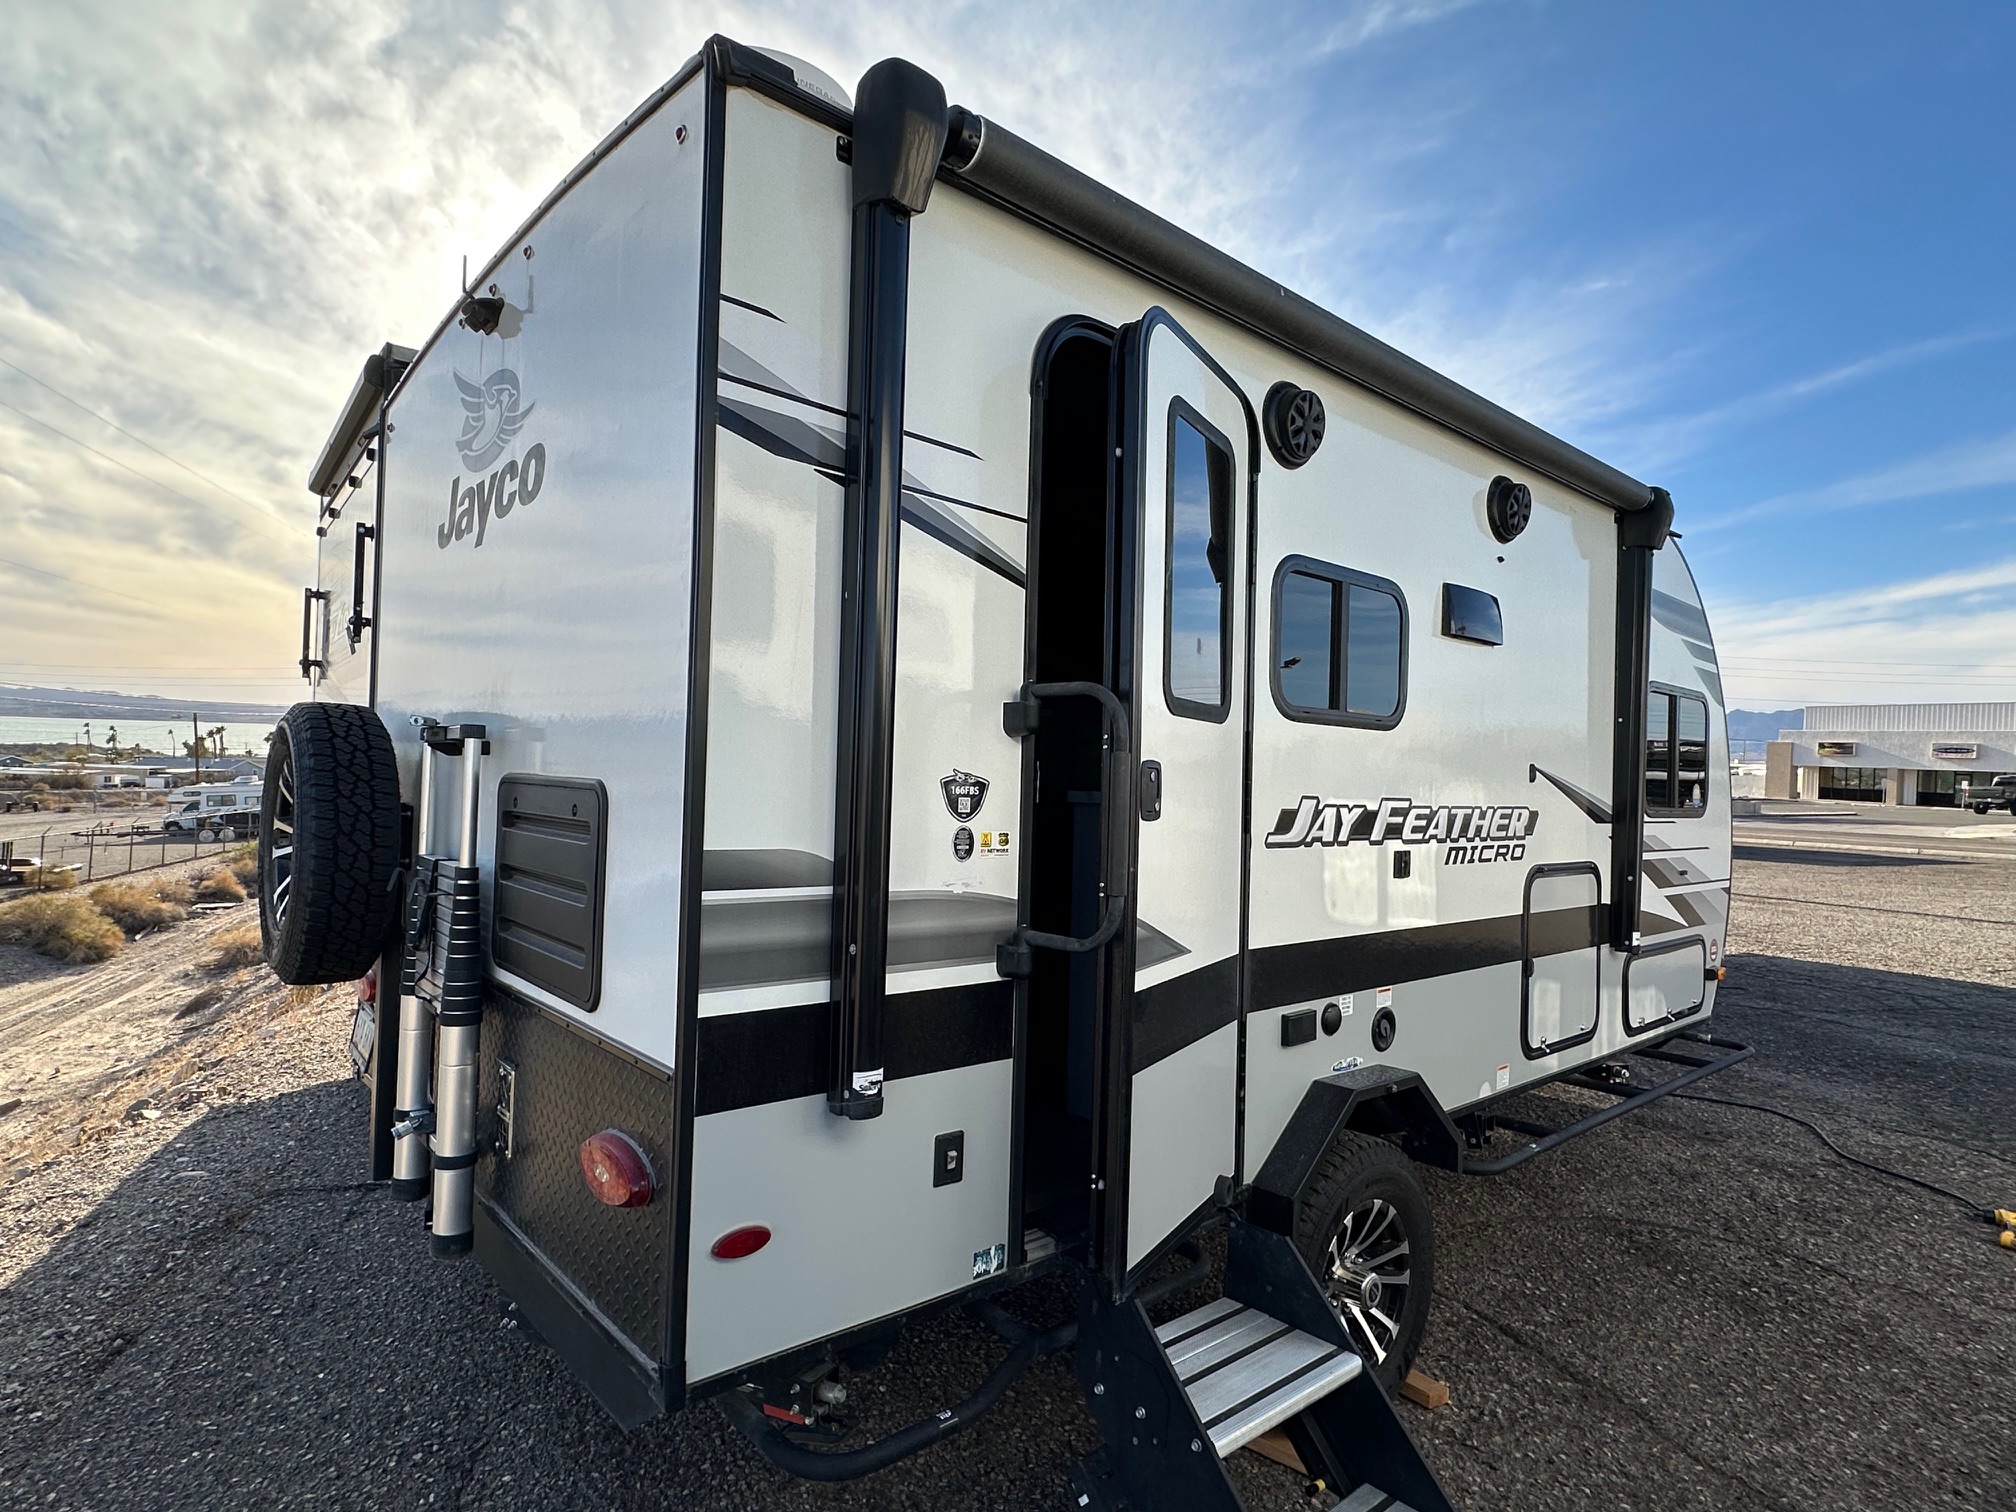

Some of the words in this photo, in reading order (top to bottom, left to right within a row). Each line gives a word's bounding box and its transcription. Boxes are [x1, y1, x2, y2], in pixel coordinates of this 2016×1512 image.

[437, 442, 546, 550] Jayco
[951, 785, 980, 795] 166FBS
[1443, 843, 1526, 866] MICRO
